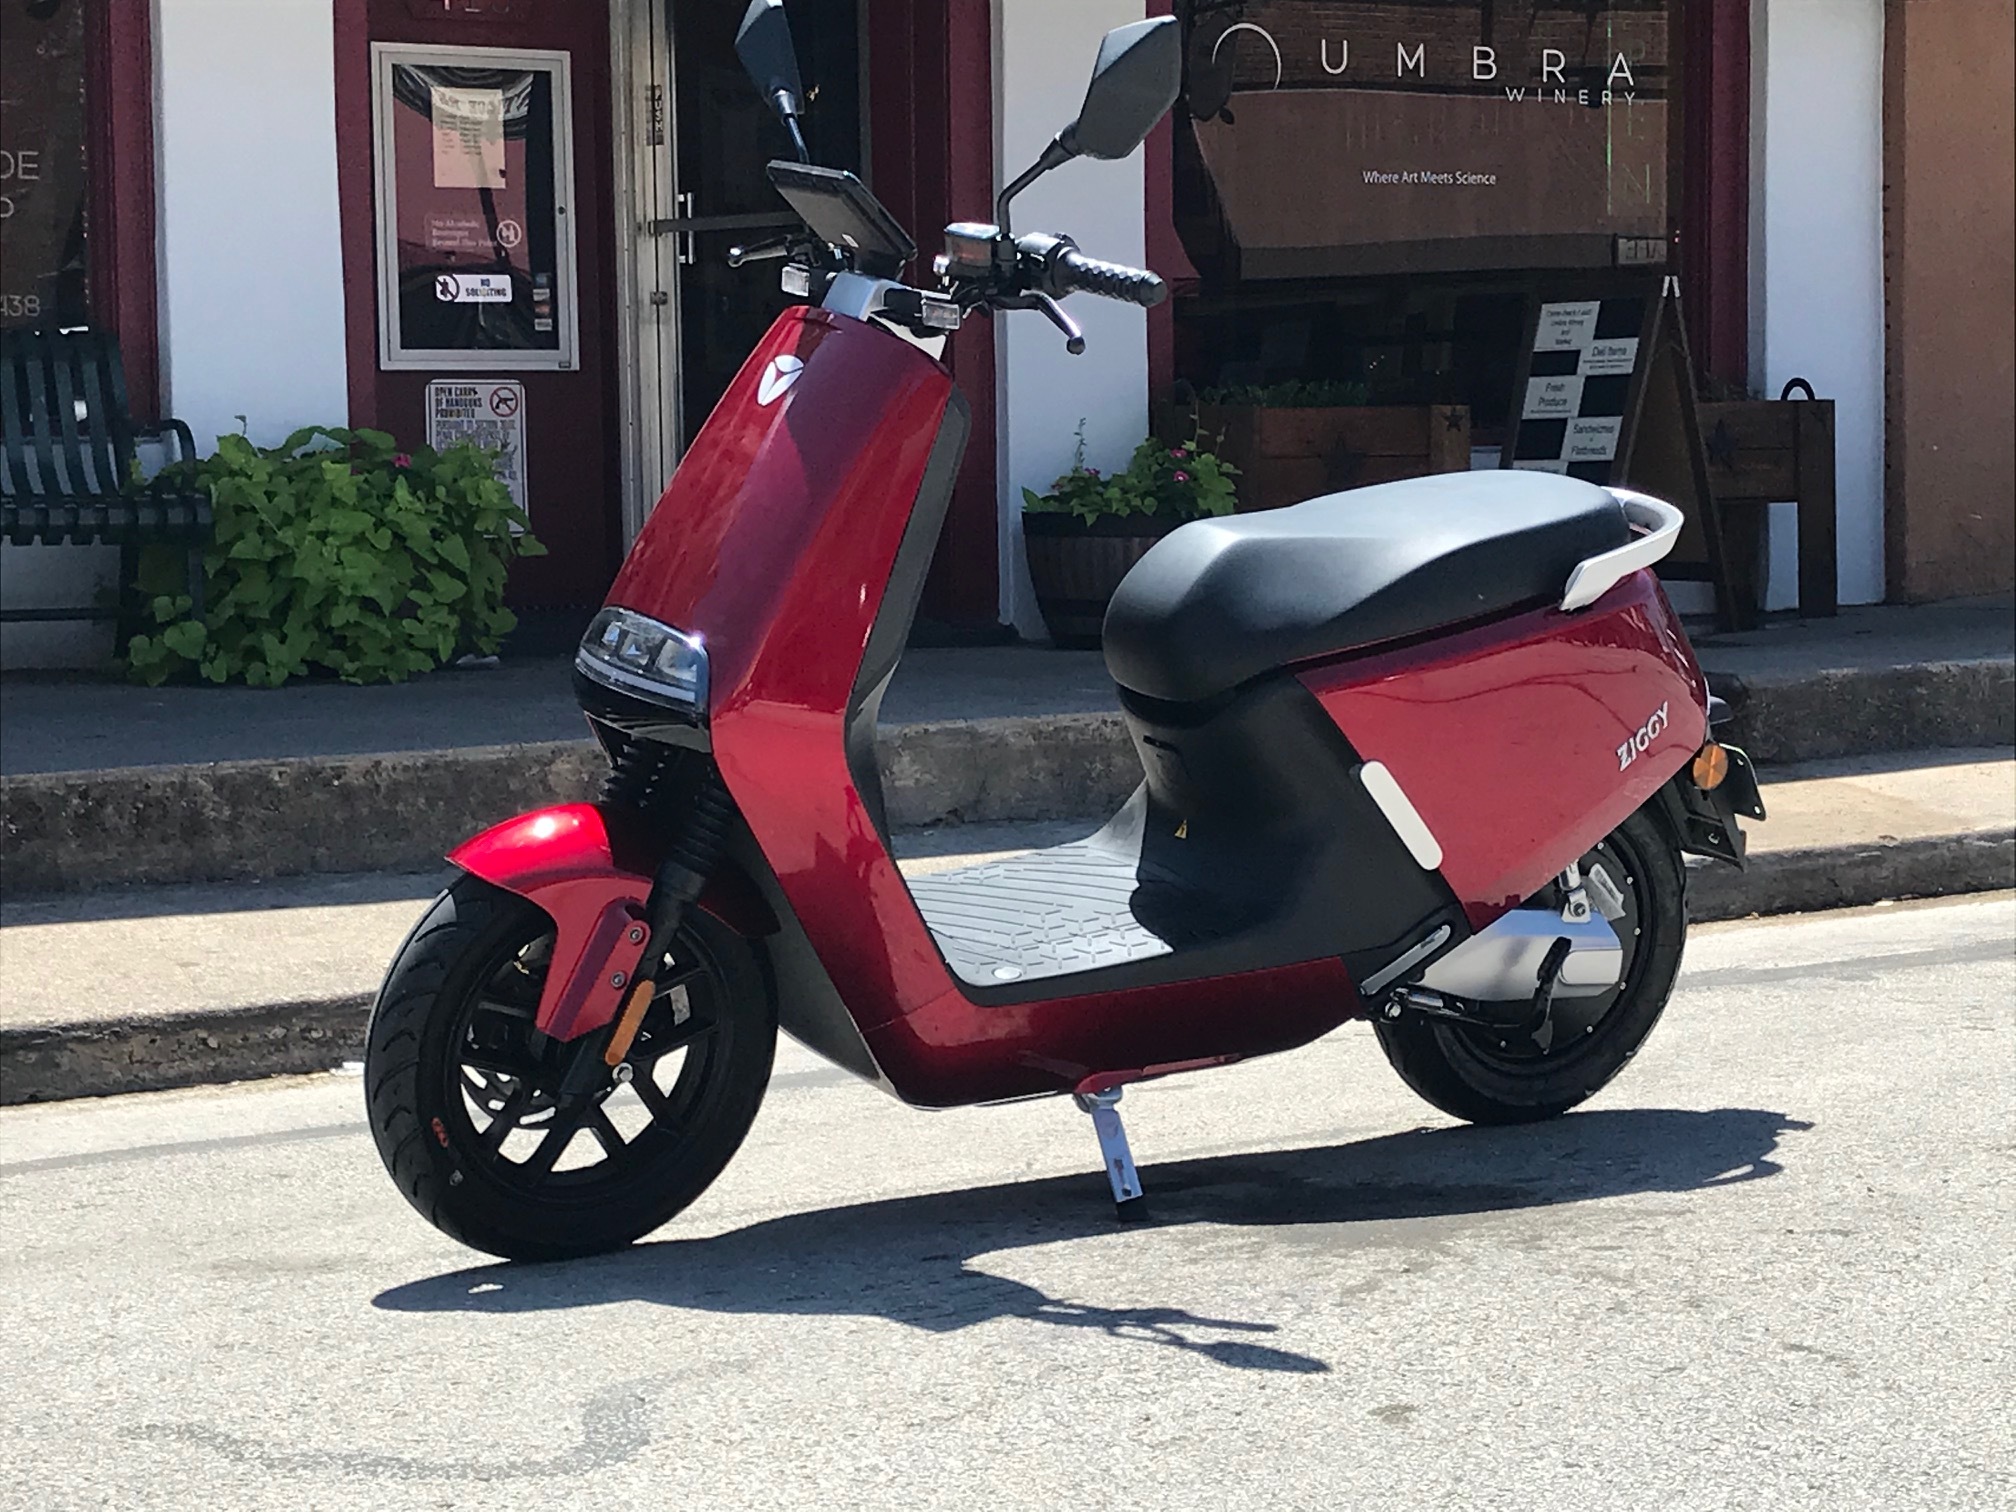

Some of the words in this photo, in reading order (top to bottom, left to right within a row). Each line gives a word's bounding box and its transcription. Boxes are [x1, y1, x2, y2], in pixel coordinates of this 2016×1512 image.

[1321, 39, 1635, 86] UMBRA
[1505, 86, 1635, 105] WINERY
[1362, 171, 1399, 184] Where
[1401, 171, 1419, 184] Art
[1421, 171, 1453, 184] Meets
[1455, 171, 1497, 185] Science
[465, 288, 507, 297] SOLICITING
[1616, 701, 1668, 771] ZIGGY
